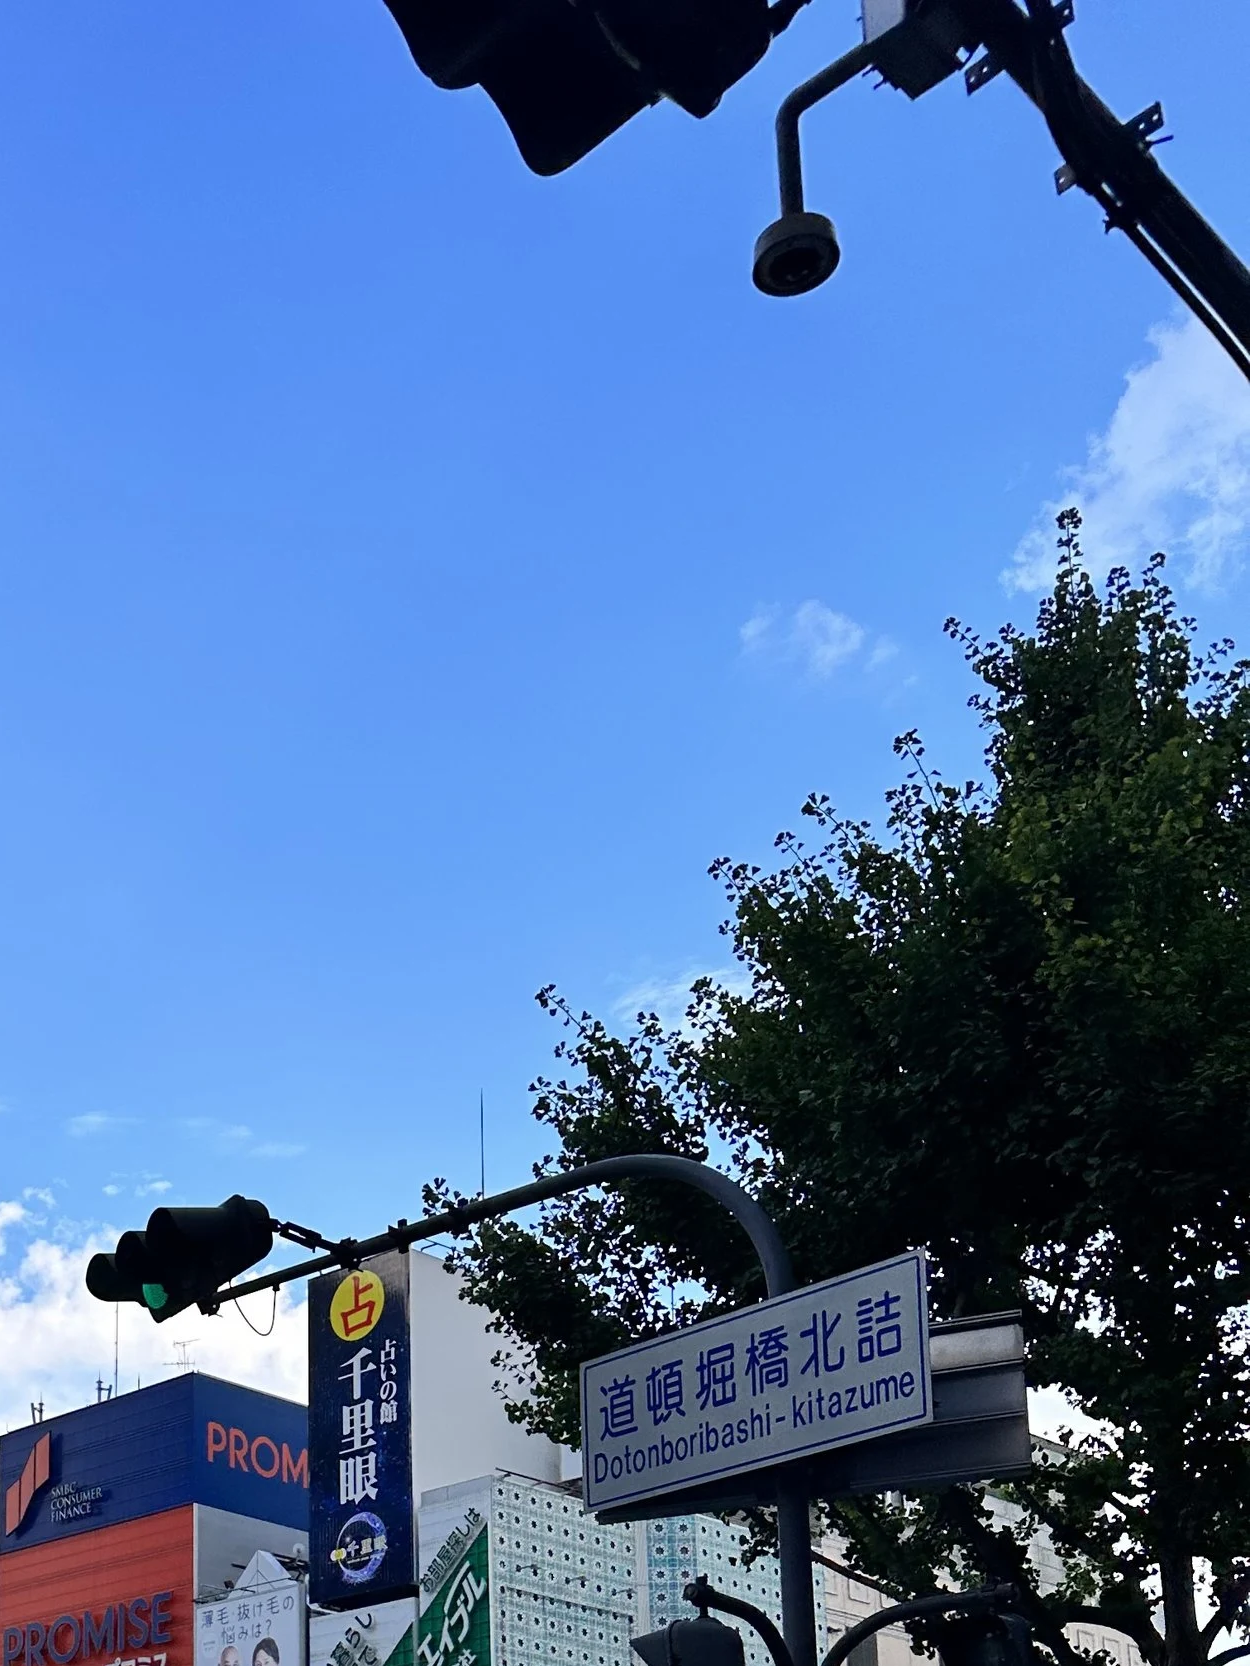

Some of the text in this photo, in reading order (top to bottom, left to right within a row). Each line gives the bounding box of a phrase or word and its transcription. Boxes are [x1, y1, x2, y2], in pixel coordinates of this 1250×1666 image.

[340, 1276, 377, 1338] 占
[379, 1338, 399, 1424] 占いの館
[599, 1290, 902, 1442] 道頓堀橋北詰
[337, 1347, 379, 1506] 千里眼
[593, 1370, 916, 1484] Dotonboribashi-kitazume
[51, 1481, 76, 1498] SMBC
[51, 1487, 103, 1510] CONSUMER
[51, 1502, 91, 1522] FINANCE
[420, 1507, 481, 1593] お部屋探しは
